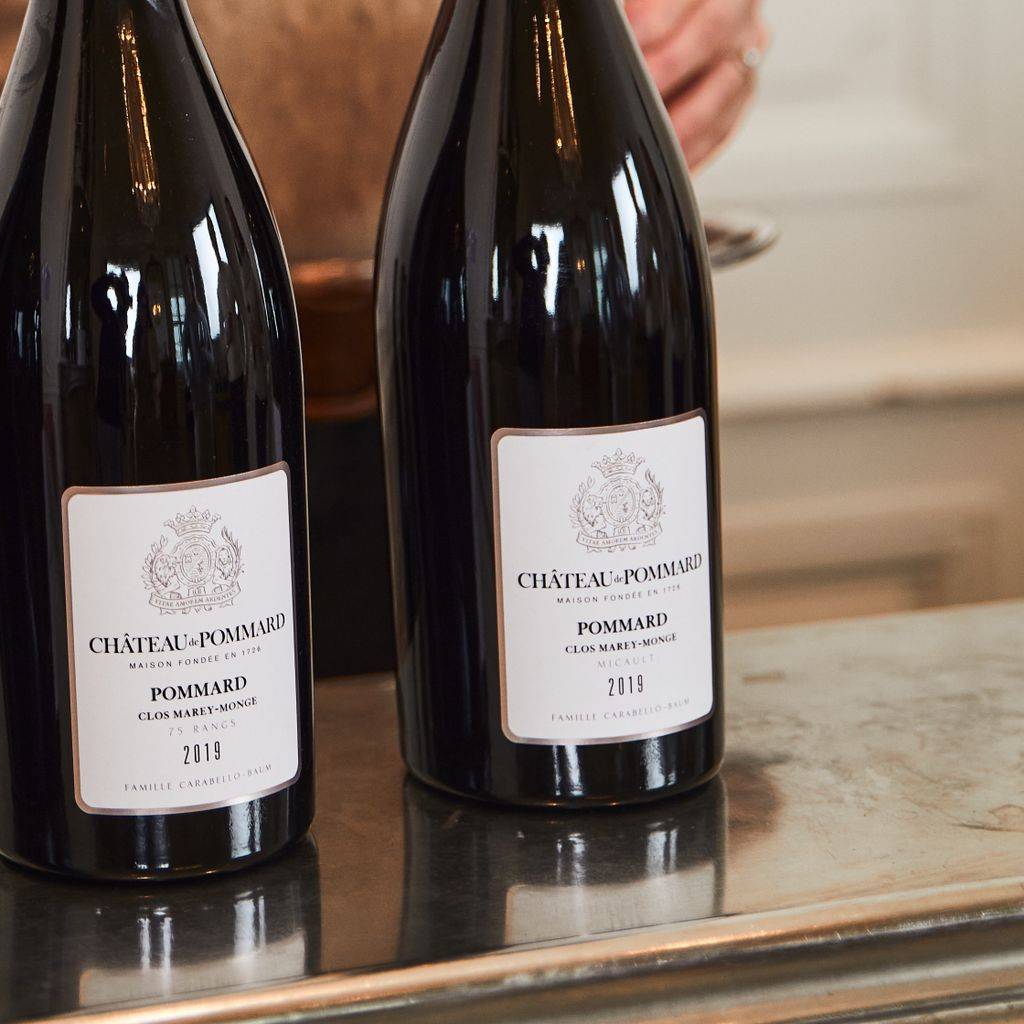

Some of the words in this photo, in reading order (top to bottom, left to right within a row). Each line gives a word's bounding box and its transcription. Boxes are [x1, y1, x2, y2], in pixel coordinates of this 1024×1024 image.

[518, 569, 613, 588] CHÂTEAU
[624, 552, 702, 584] POMMARD
[557, 596, 598, 604] MAISON
[648, 589, 658, 597] EN
[89, 633, 187, 654] CHÂTEAU
[200, 612, 285, 647] POMMARD
[577, 612, 668, 635] POMMARD
[565, 644, 596, 654] CLOS
[599, 633, 677, 652] MAREY-MONGE
[129, 661, 172, 669] MAISON
[225, 651, 237, 660] EN
[597, 654, 654, 669] MICAULT
[151, 676, 247, 701] POMMARD
[608, 674, 643, 696] 2019
[138, 711, 170, 721] CLOS
[173, 696, 258, 719] MAREY-MONGE
[551, 713, 596, 721] FAMILLE
[169, 727, 183, 736] 75
[193, 719, 236, 733] RANGS
[183, 741, 221, 764] 2019
[124, 782, 172, 791] FAMILLE
